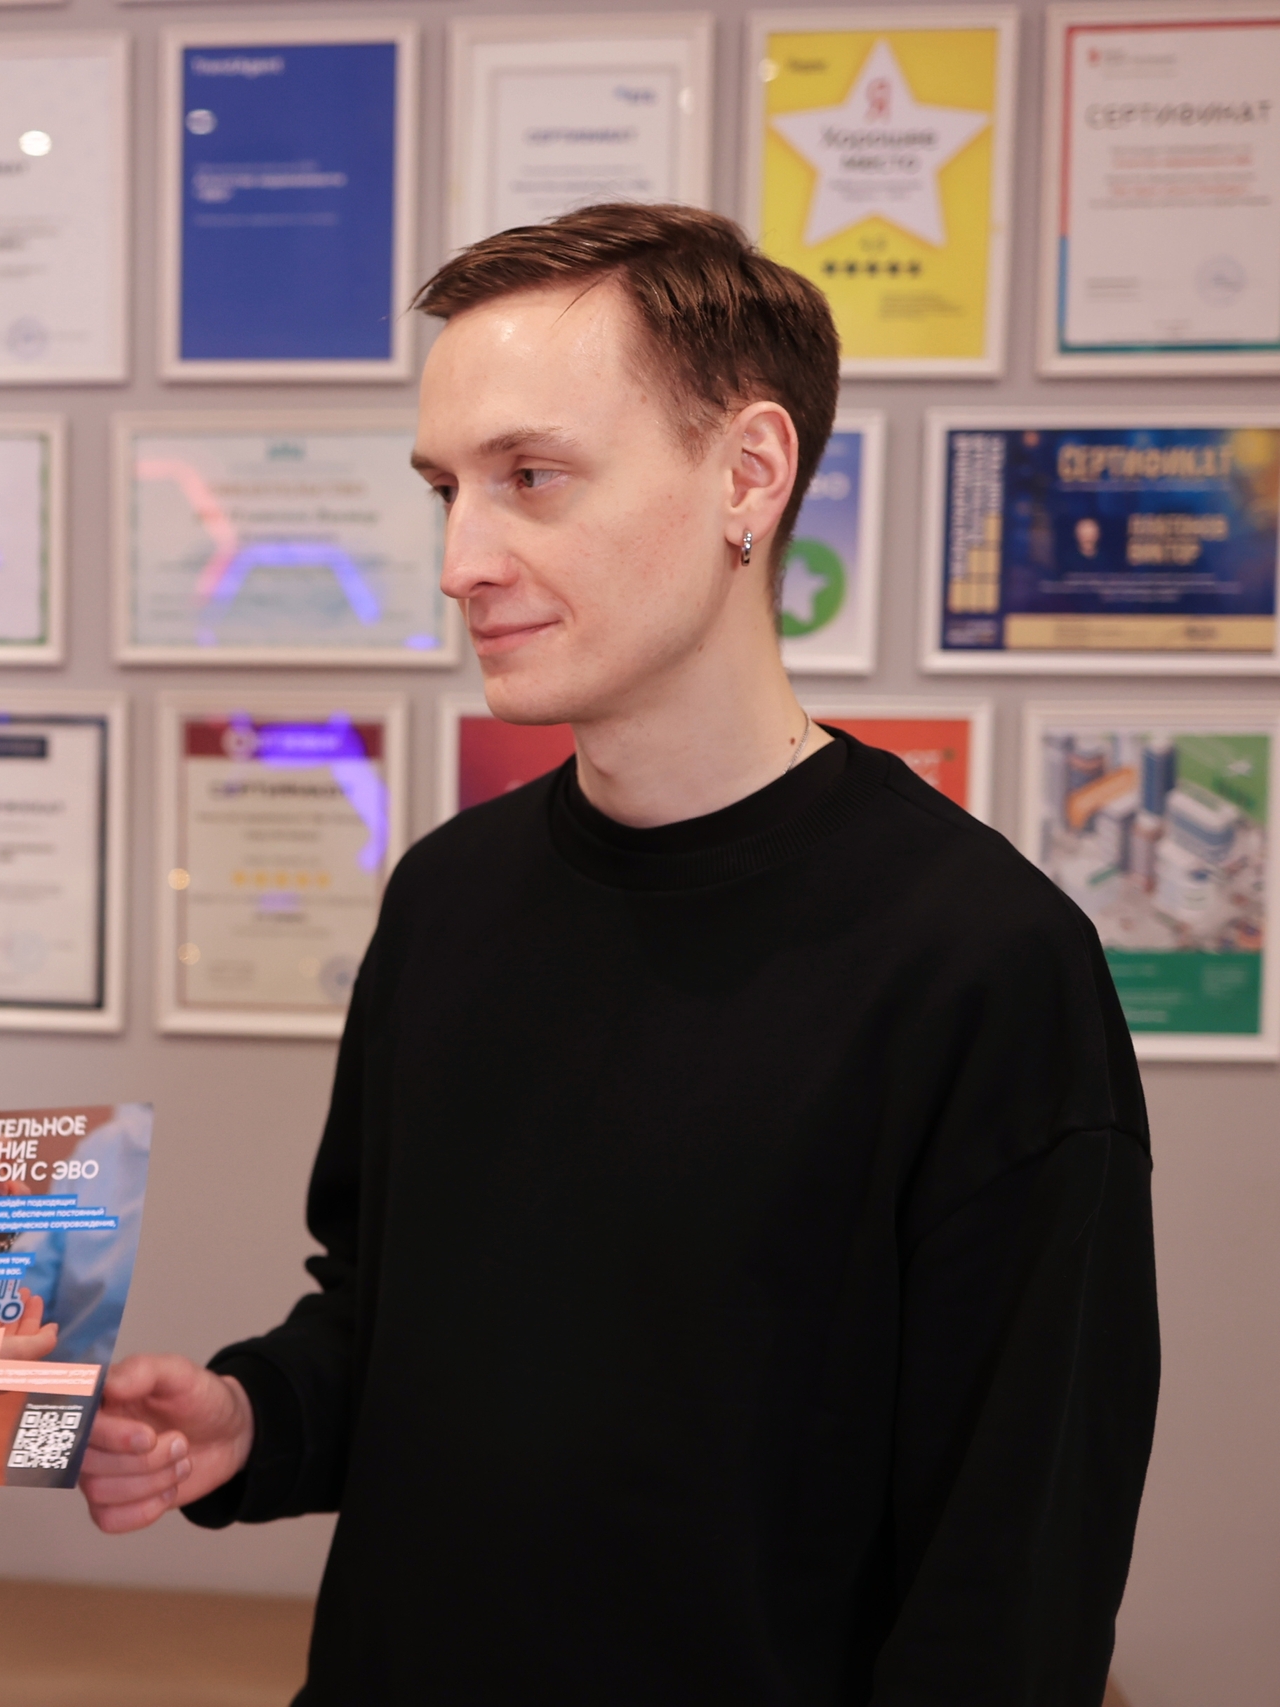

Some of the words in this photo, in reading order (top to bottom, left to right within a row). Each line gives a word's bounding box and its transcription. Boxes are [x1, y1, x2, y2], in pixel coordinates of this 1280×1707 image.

[30, 1162, 47, 1181] С
[51, 1160, 99, 1180] ЭВО
[27, 1198, 76, 1208] подходящих
[11, 1210, 55, 1218] обеспечим
[56, 1207, 105, 1217] постоянный
